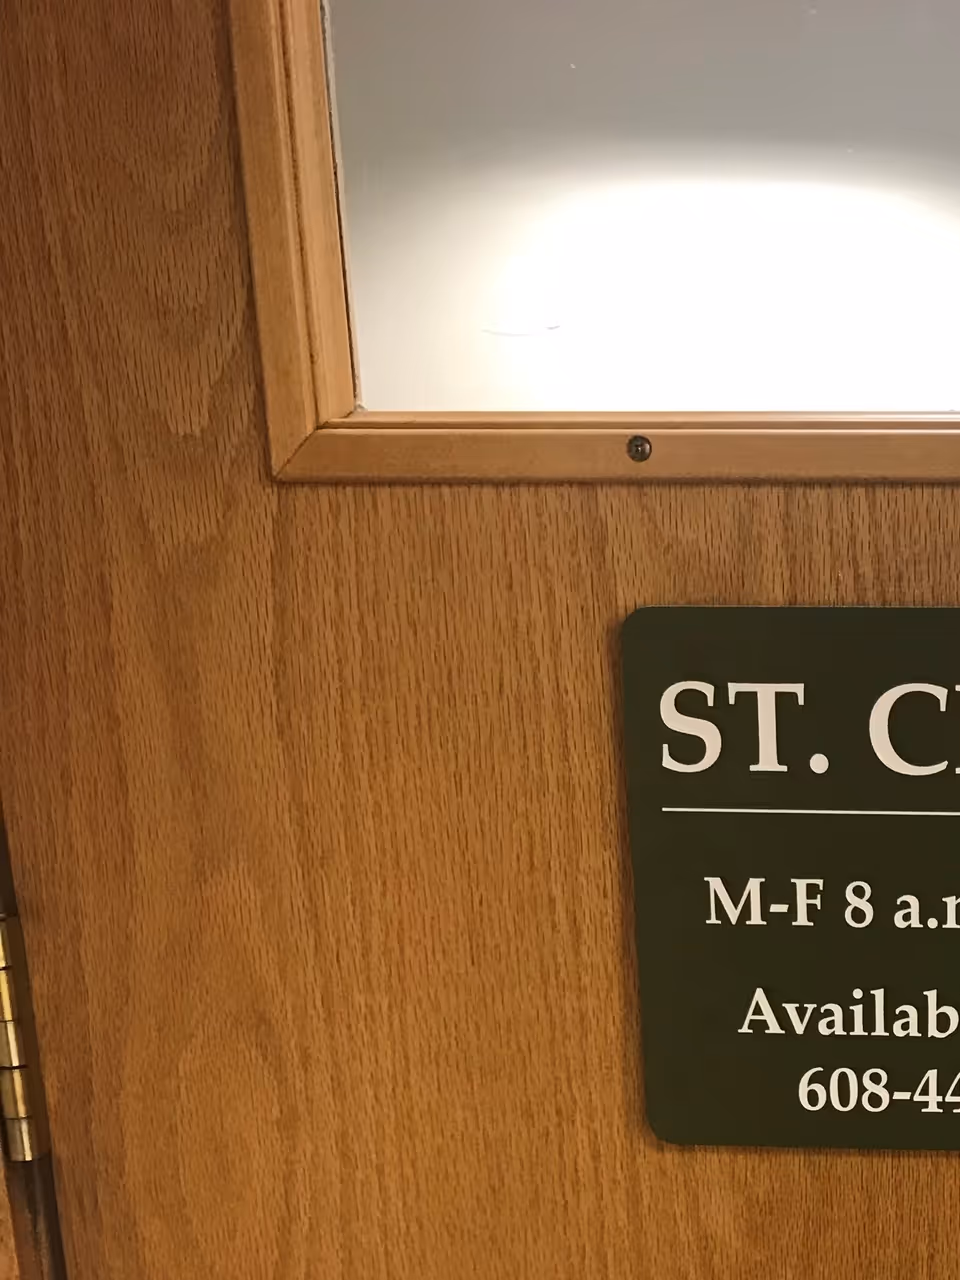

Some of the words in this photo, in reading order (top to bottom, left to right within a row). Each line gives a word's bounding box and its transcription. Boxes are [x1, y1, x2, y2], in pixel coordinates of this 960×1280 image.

[659, 680, 829, 774] ST.
[703, 876, 824, 928] M-F
[844, 880, 874, 928] 8
